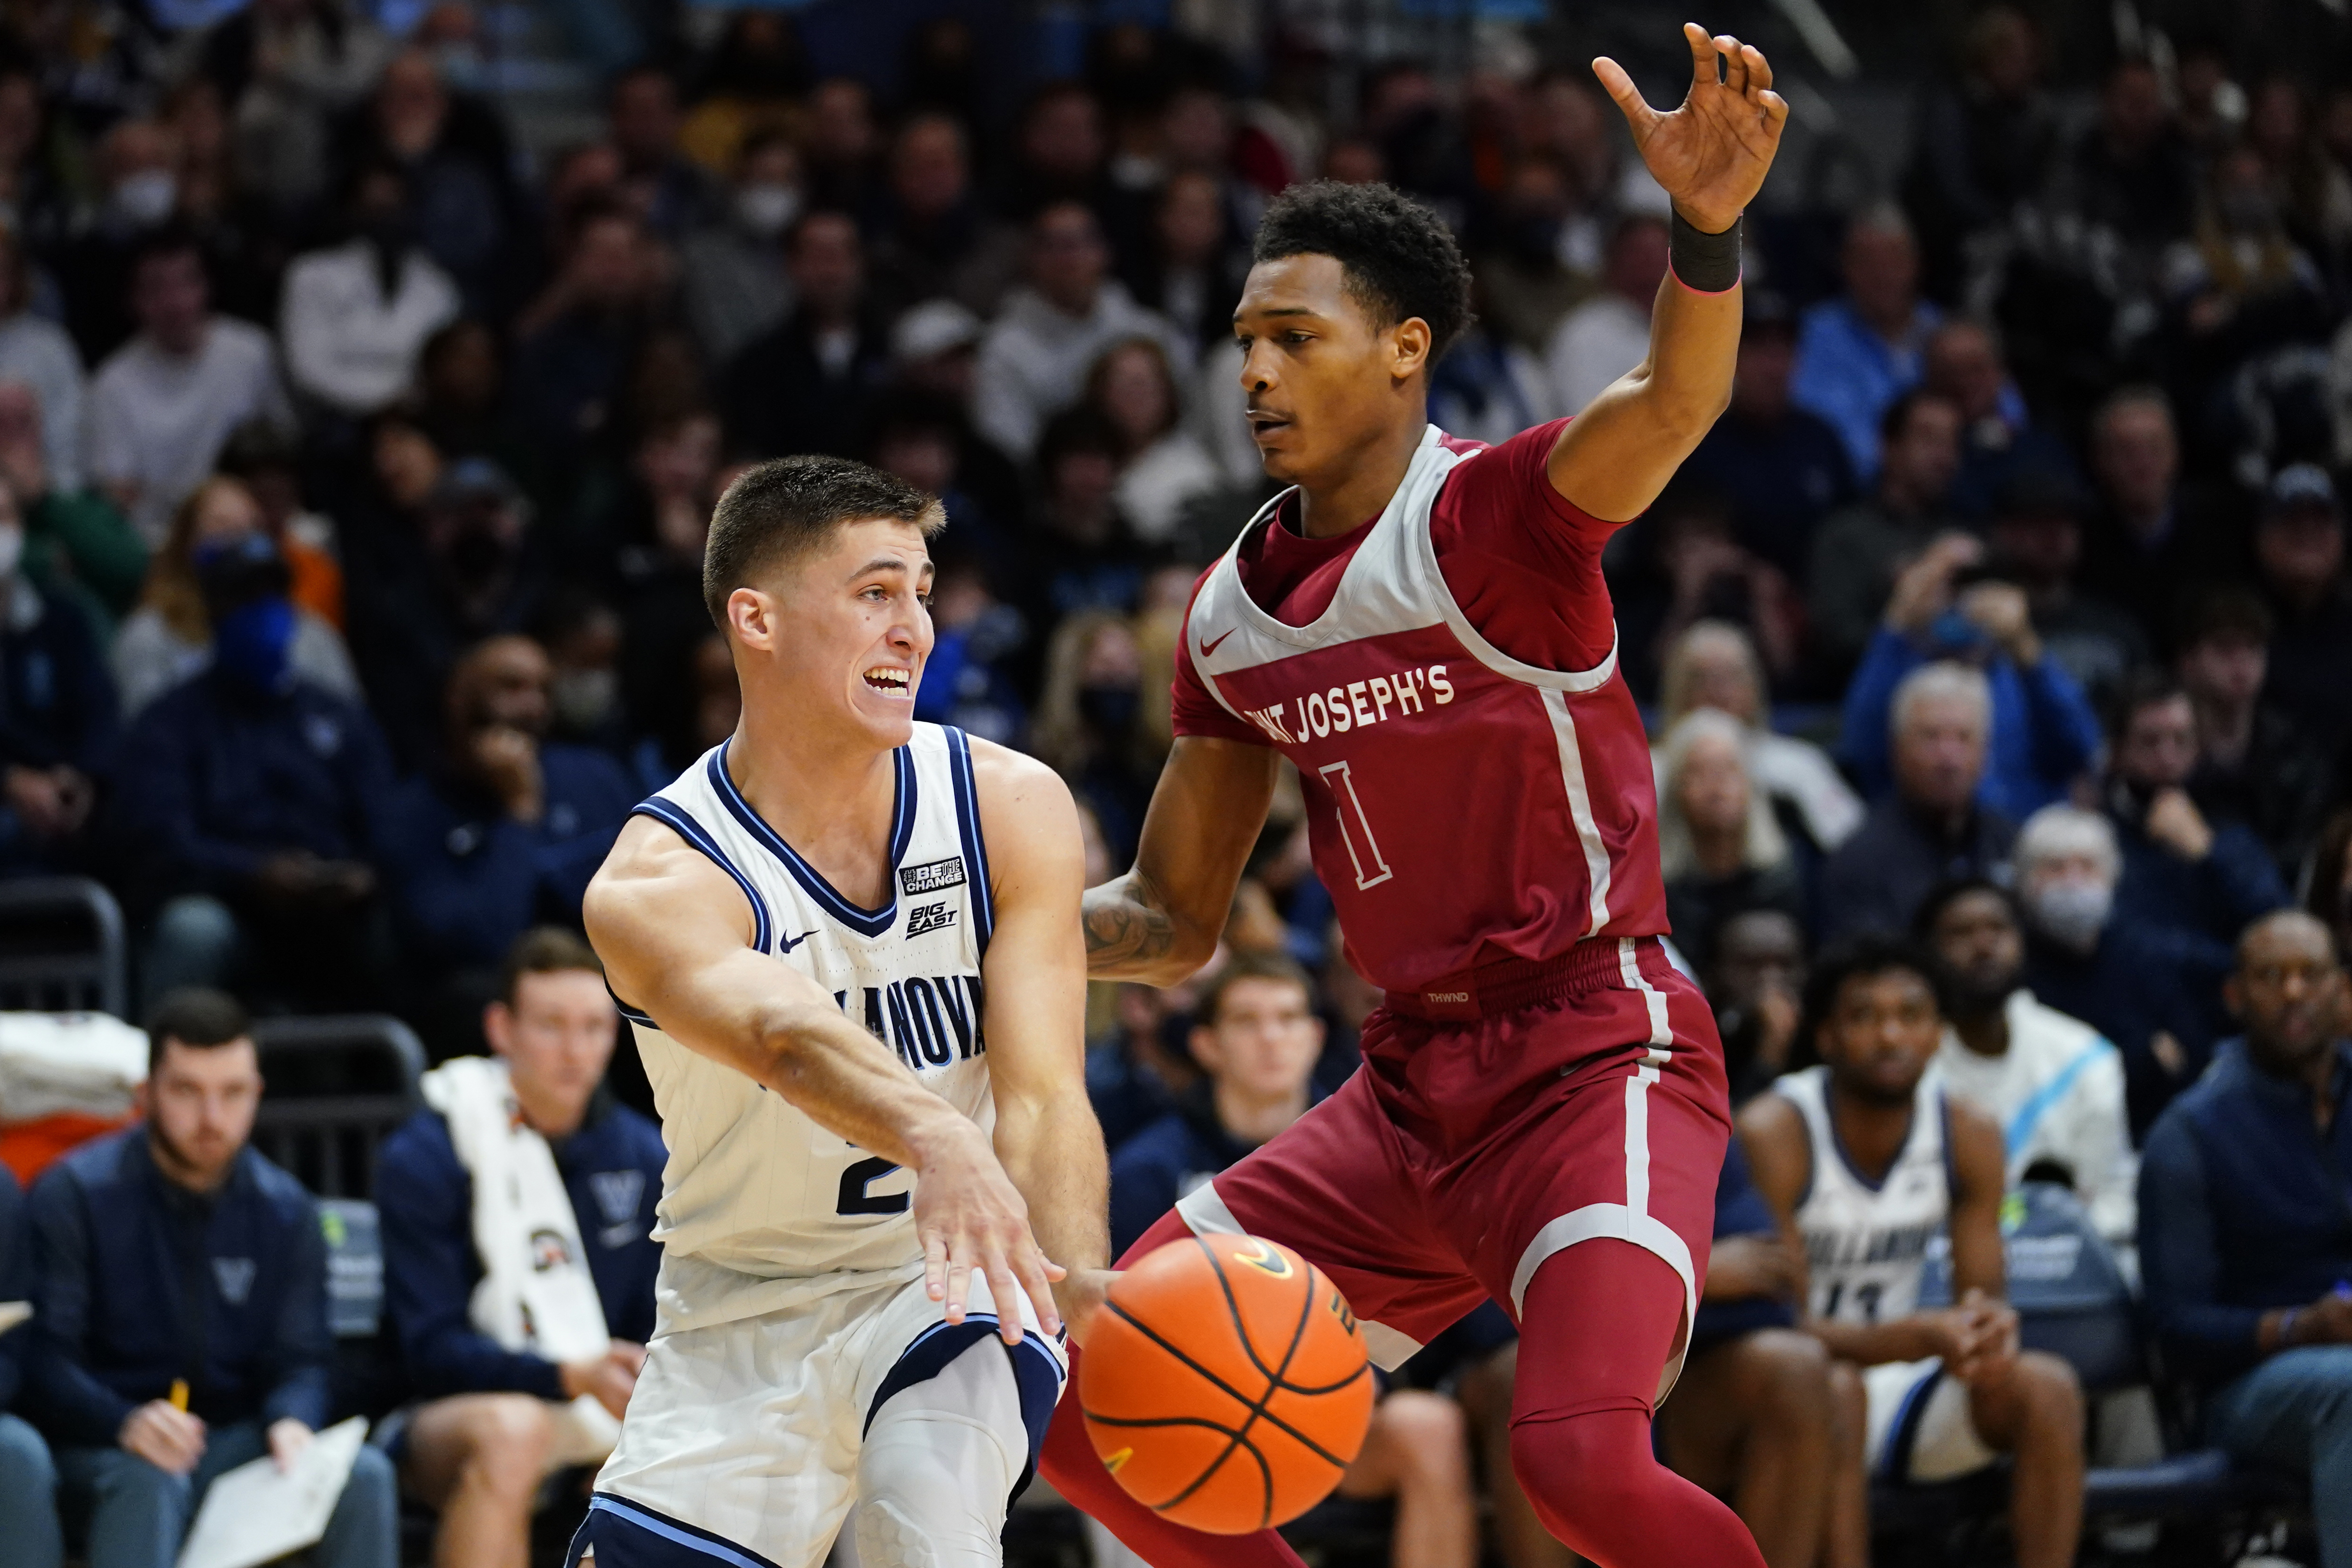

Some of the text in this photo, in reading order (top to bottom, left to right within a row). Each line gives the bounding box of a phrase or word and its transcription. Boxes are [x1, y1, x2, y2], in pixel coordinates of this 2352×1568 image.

[1296, 665, 1454, 743] JOSEPH'S
[906, 871, 962, 892] CHANGE
[907, 910, 957, 933] EAST
[909, 901, 946, 921] BIG
[1428, 992, 1469, 1002] THWND
